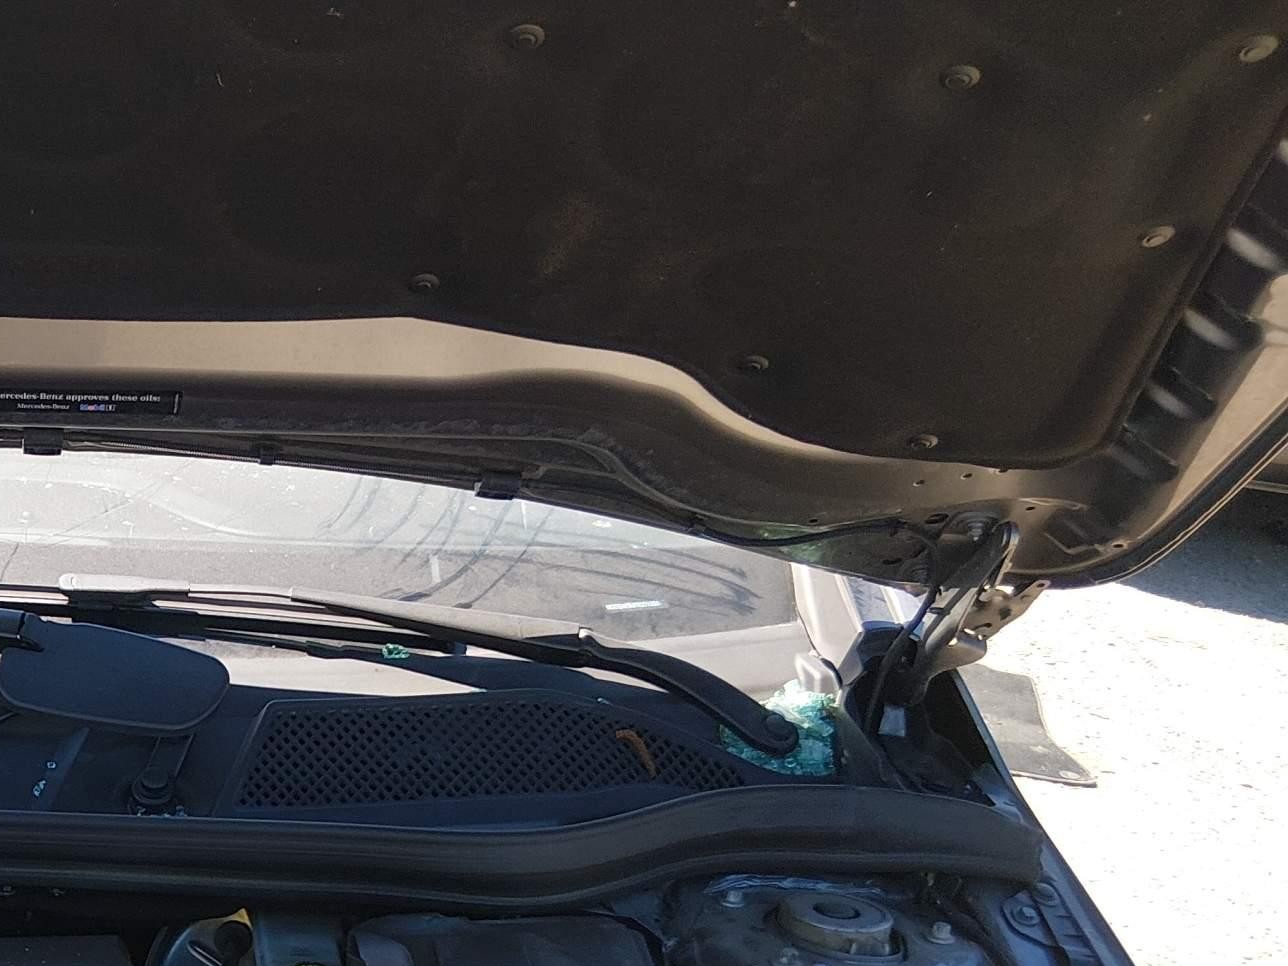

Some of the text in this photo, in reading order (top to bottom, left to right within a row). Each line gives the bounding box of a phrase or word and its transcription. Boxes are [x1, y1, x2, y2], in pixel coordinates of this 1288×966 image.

[65, 393, 109, 402] approves
[111, 393, 138, 402] these
[17, 402, 70, 410] Mercedes-Benz
